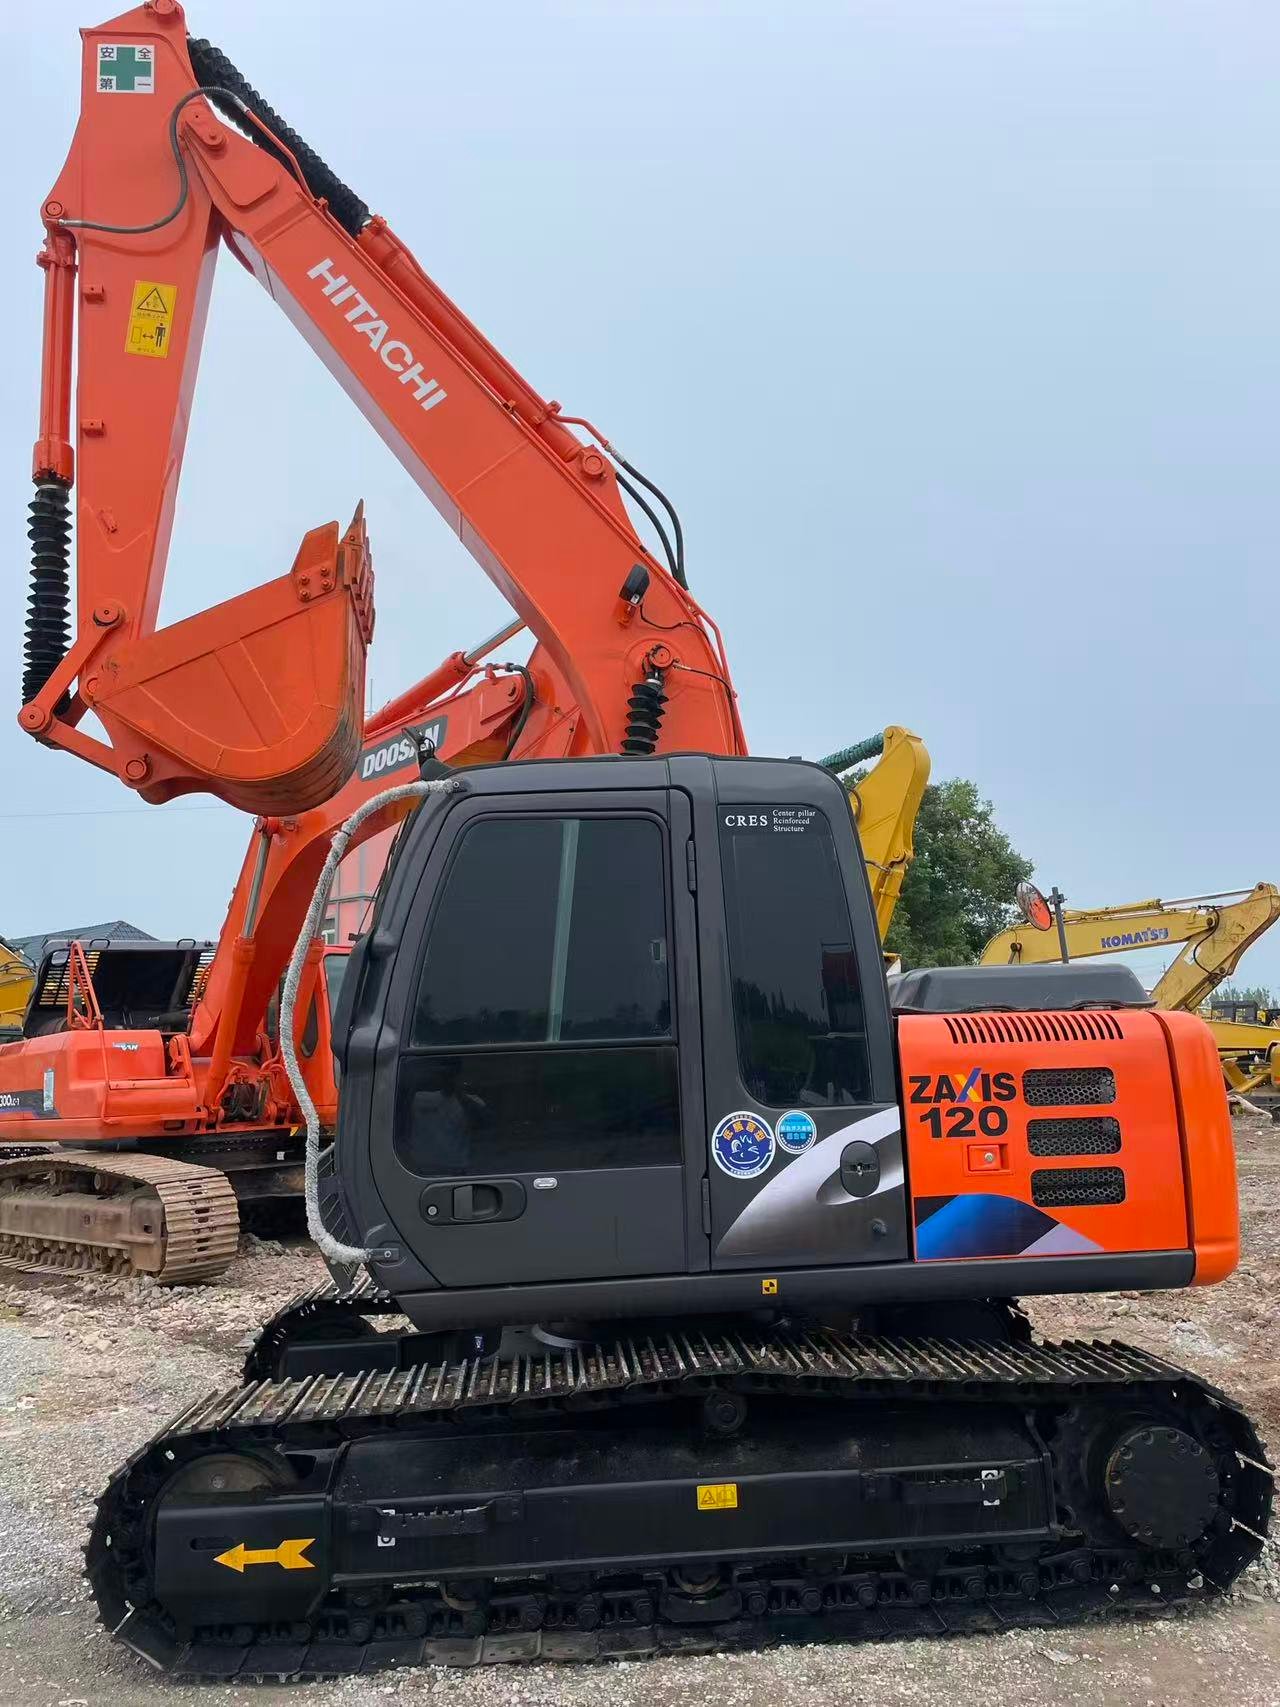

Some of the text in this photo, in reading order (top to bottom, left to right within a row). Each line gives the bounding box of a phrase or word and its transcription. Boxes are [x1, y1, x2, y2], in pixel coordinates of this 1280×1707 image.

[100, 47, 152, 60] 安全
[100, 77, 152, 90] 第一
[306, 257, 448, 411] HITACHI
[361, 723, 440, 779] DOOSN
[725, 815, 768, 827] CRES
[772, 809, 816, 818] Center pillar
[773, 817, 810, 825] Reinforced
[1101, 927, 1169, 949] KOMATSU
[908, 1067, 1018, 1104] ZAXIS
[919, 1105, 1009, 1139] 120
